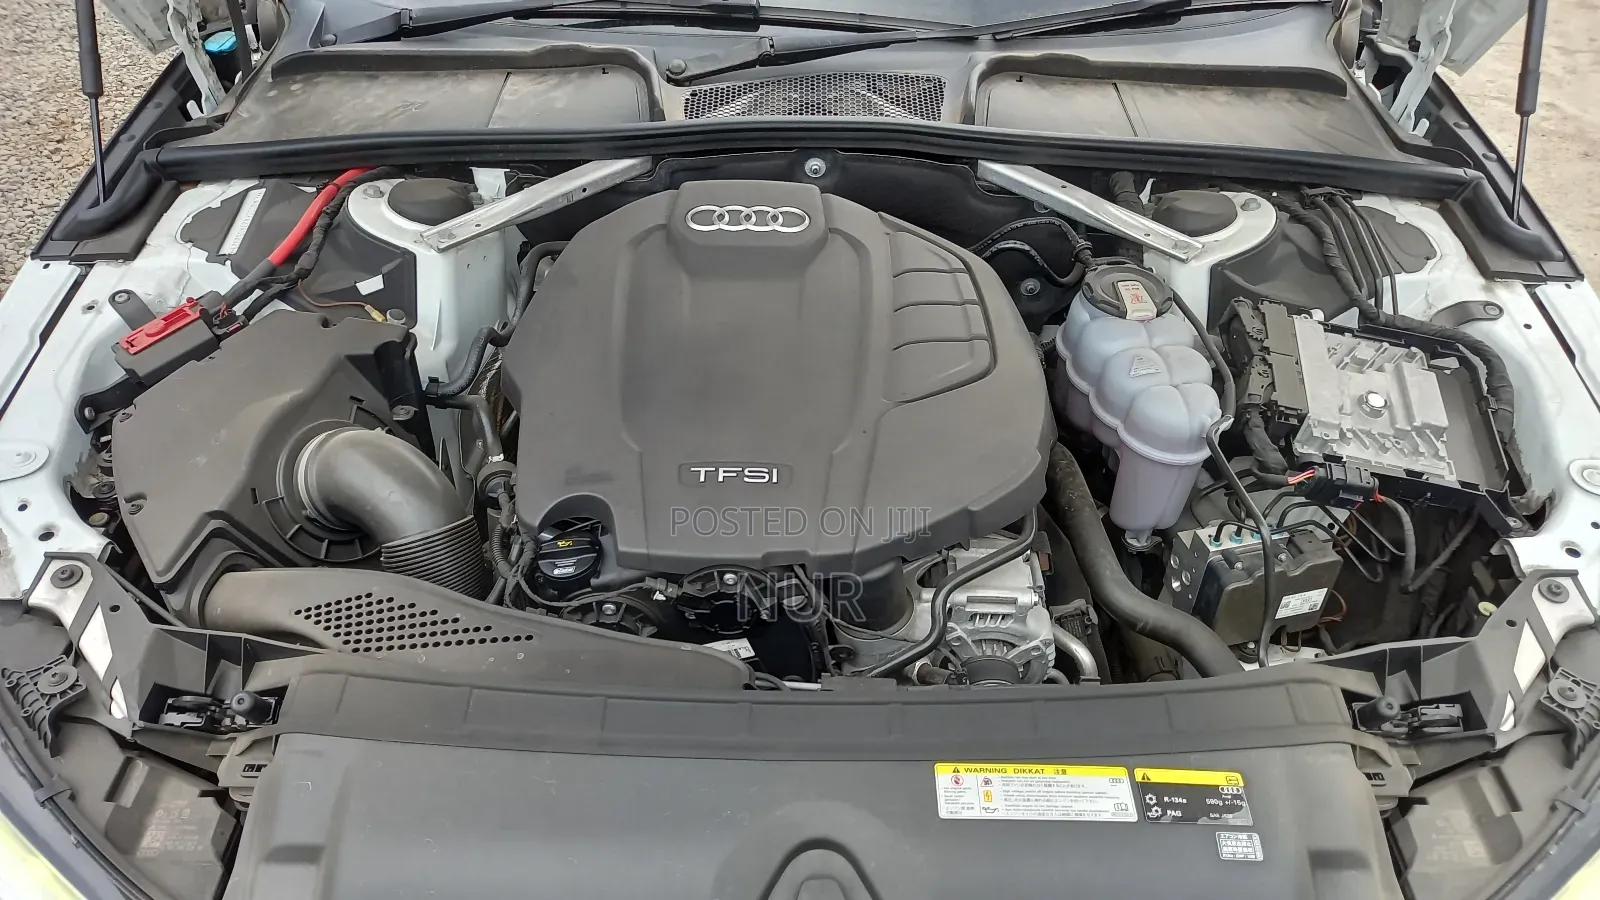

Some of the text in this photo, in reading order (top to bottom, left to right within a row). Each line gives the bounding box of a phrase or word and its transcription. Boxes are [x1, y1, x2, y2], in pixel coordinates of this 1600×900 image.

[690, 467, 779, 484] TFSI
[1163, 796, 1188, 804] R-134a
[1166, 809, 1183, 817] PAG
